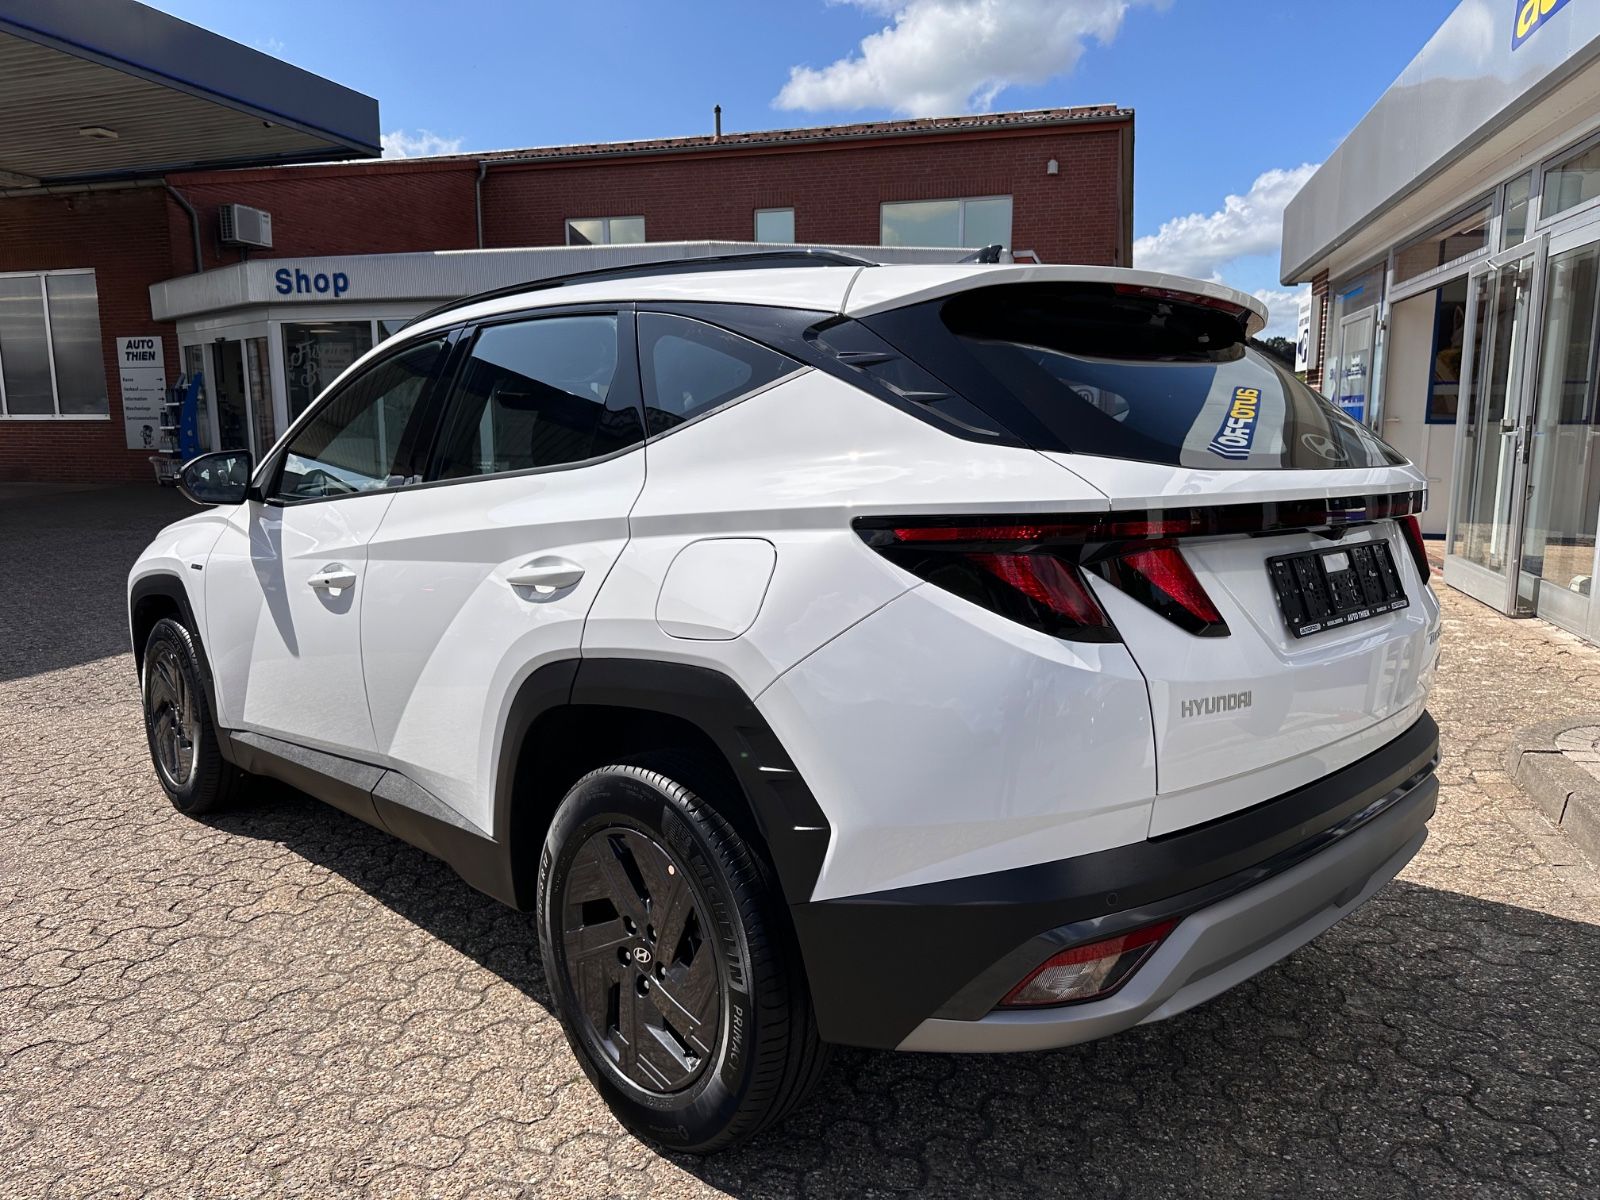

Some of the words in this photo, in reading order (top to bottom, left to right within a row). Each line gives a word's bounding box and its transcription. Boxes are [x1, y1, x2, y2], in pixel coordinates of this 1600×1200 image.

[275, 268, 349, 297] Shop
[126, 339, 154, 350] AUTO
[125, 351, 155, 361] THIEN
[1347, 612, 1359, 622] AUTO
[1182, 691, 1252, 718] HYUNDAI
[728, 1004, 743, 1071] PRIMACY
